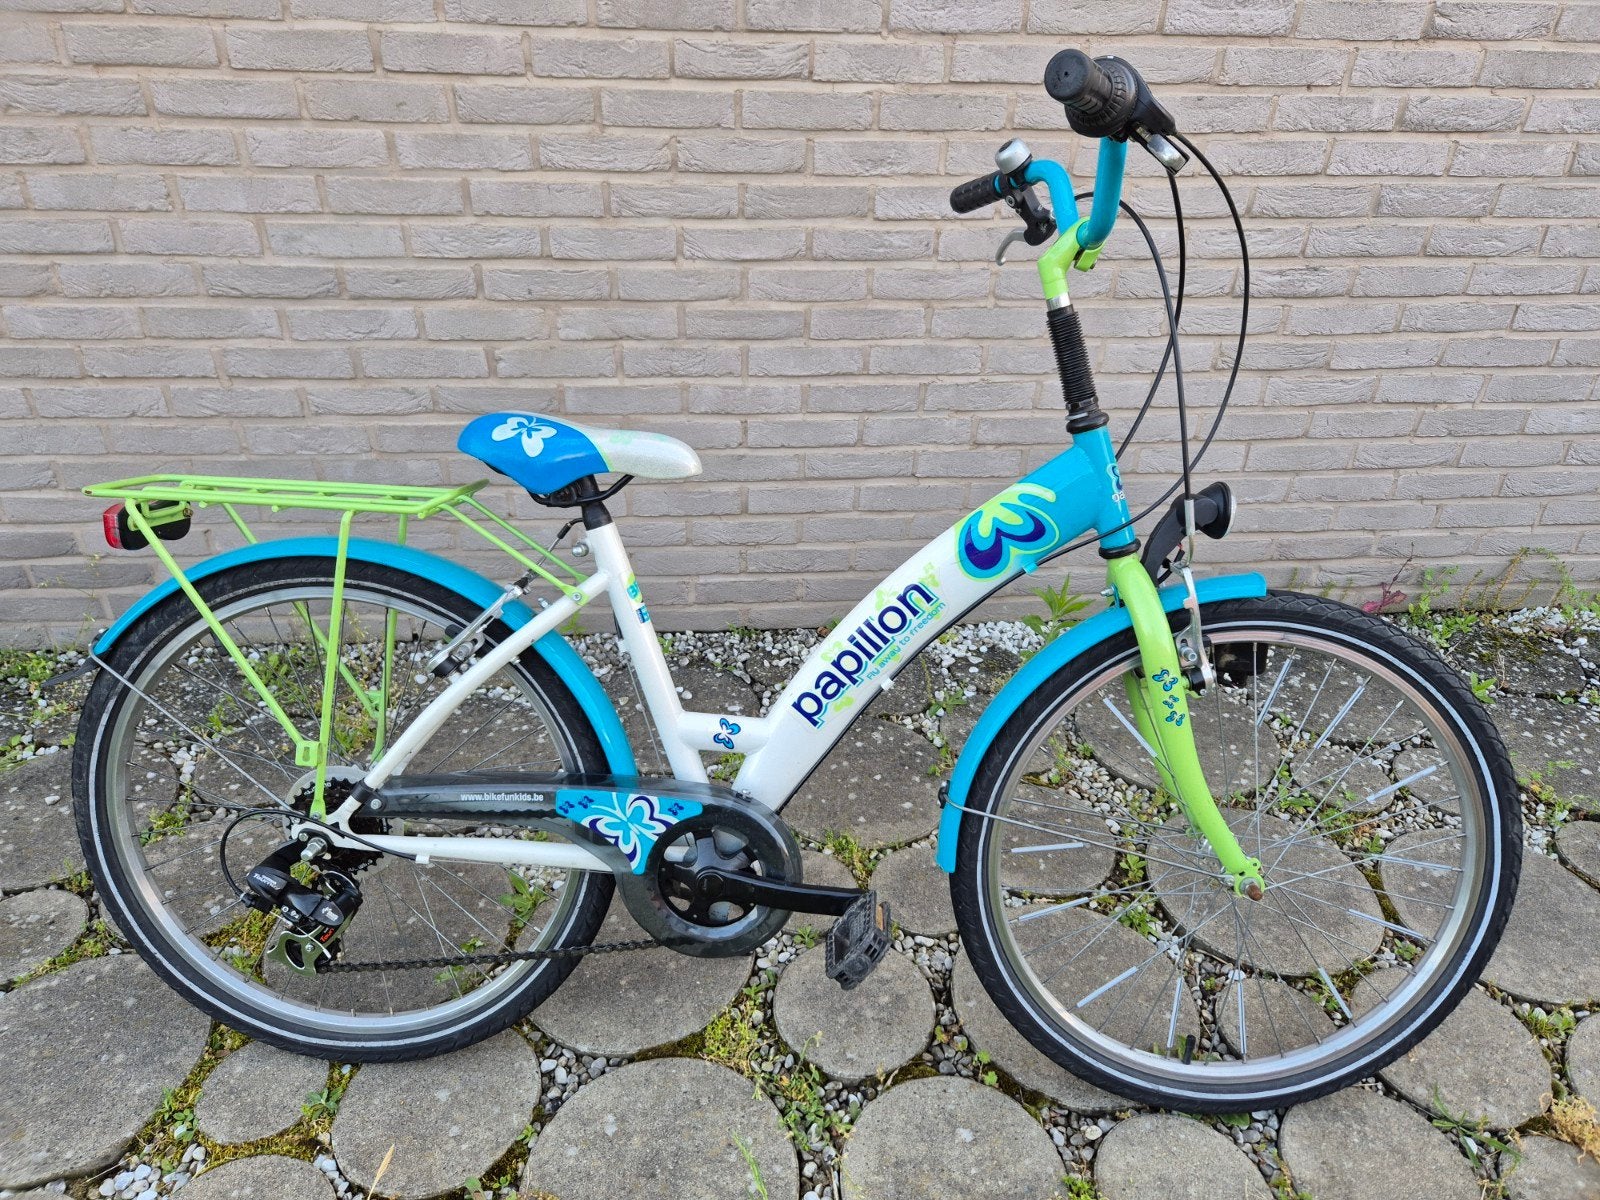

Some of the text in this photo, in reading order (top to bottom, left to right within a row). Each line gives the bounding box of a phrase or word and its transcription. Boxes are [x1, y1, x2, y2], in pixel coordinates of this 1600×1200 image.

[791, 582, 938, 728] papillon
[879, 645, 902, 669] away
[899, 635, 911, 646] to
[909, 602, 946, 636] freedom
[460, 792, 544, 802] www.bikefunkids.be
